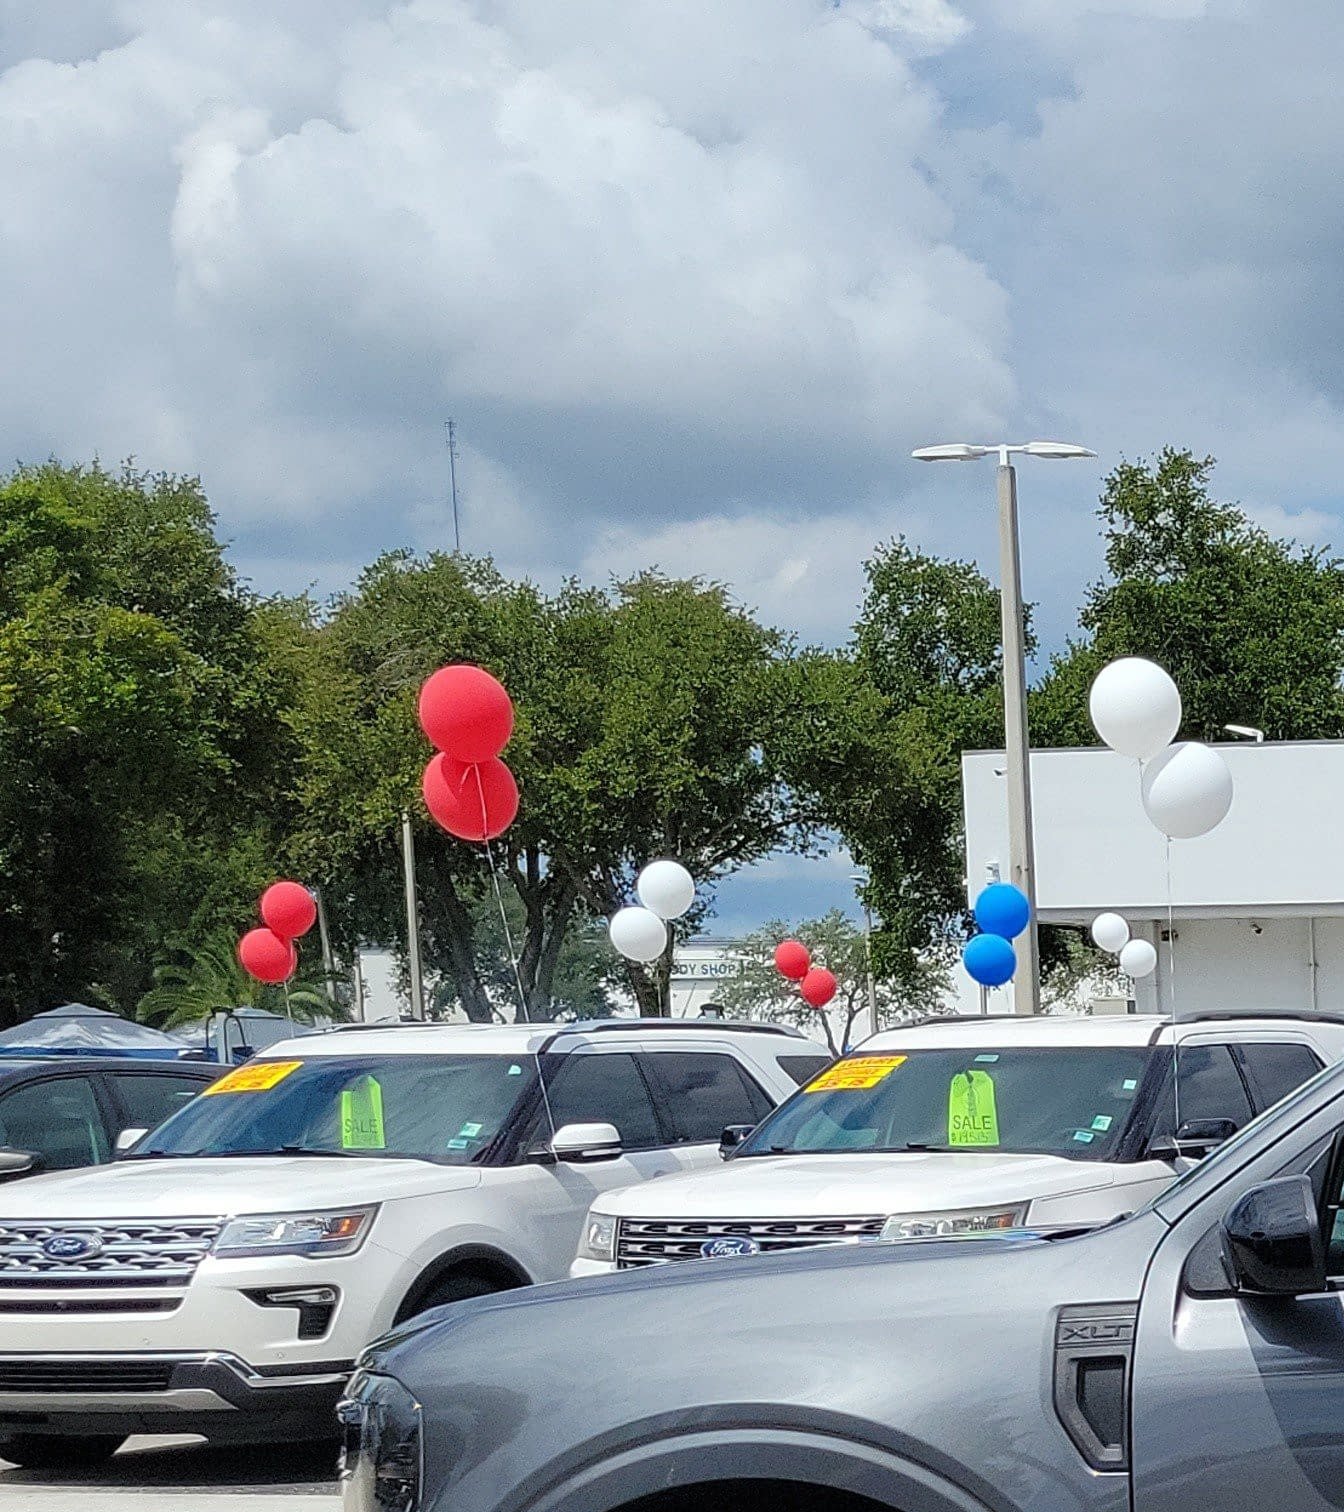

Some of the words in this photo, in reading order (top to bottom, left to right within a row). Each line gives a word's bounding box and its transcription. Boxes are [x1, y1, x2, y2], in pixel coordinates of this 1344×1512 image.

[701, 963, 736, 976] SHOP
[345, 1118, 378, 1134] SALE
[952, 1115, 993, 1130] SALE
[1062, 1324, 1133, 1341] XLT
